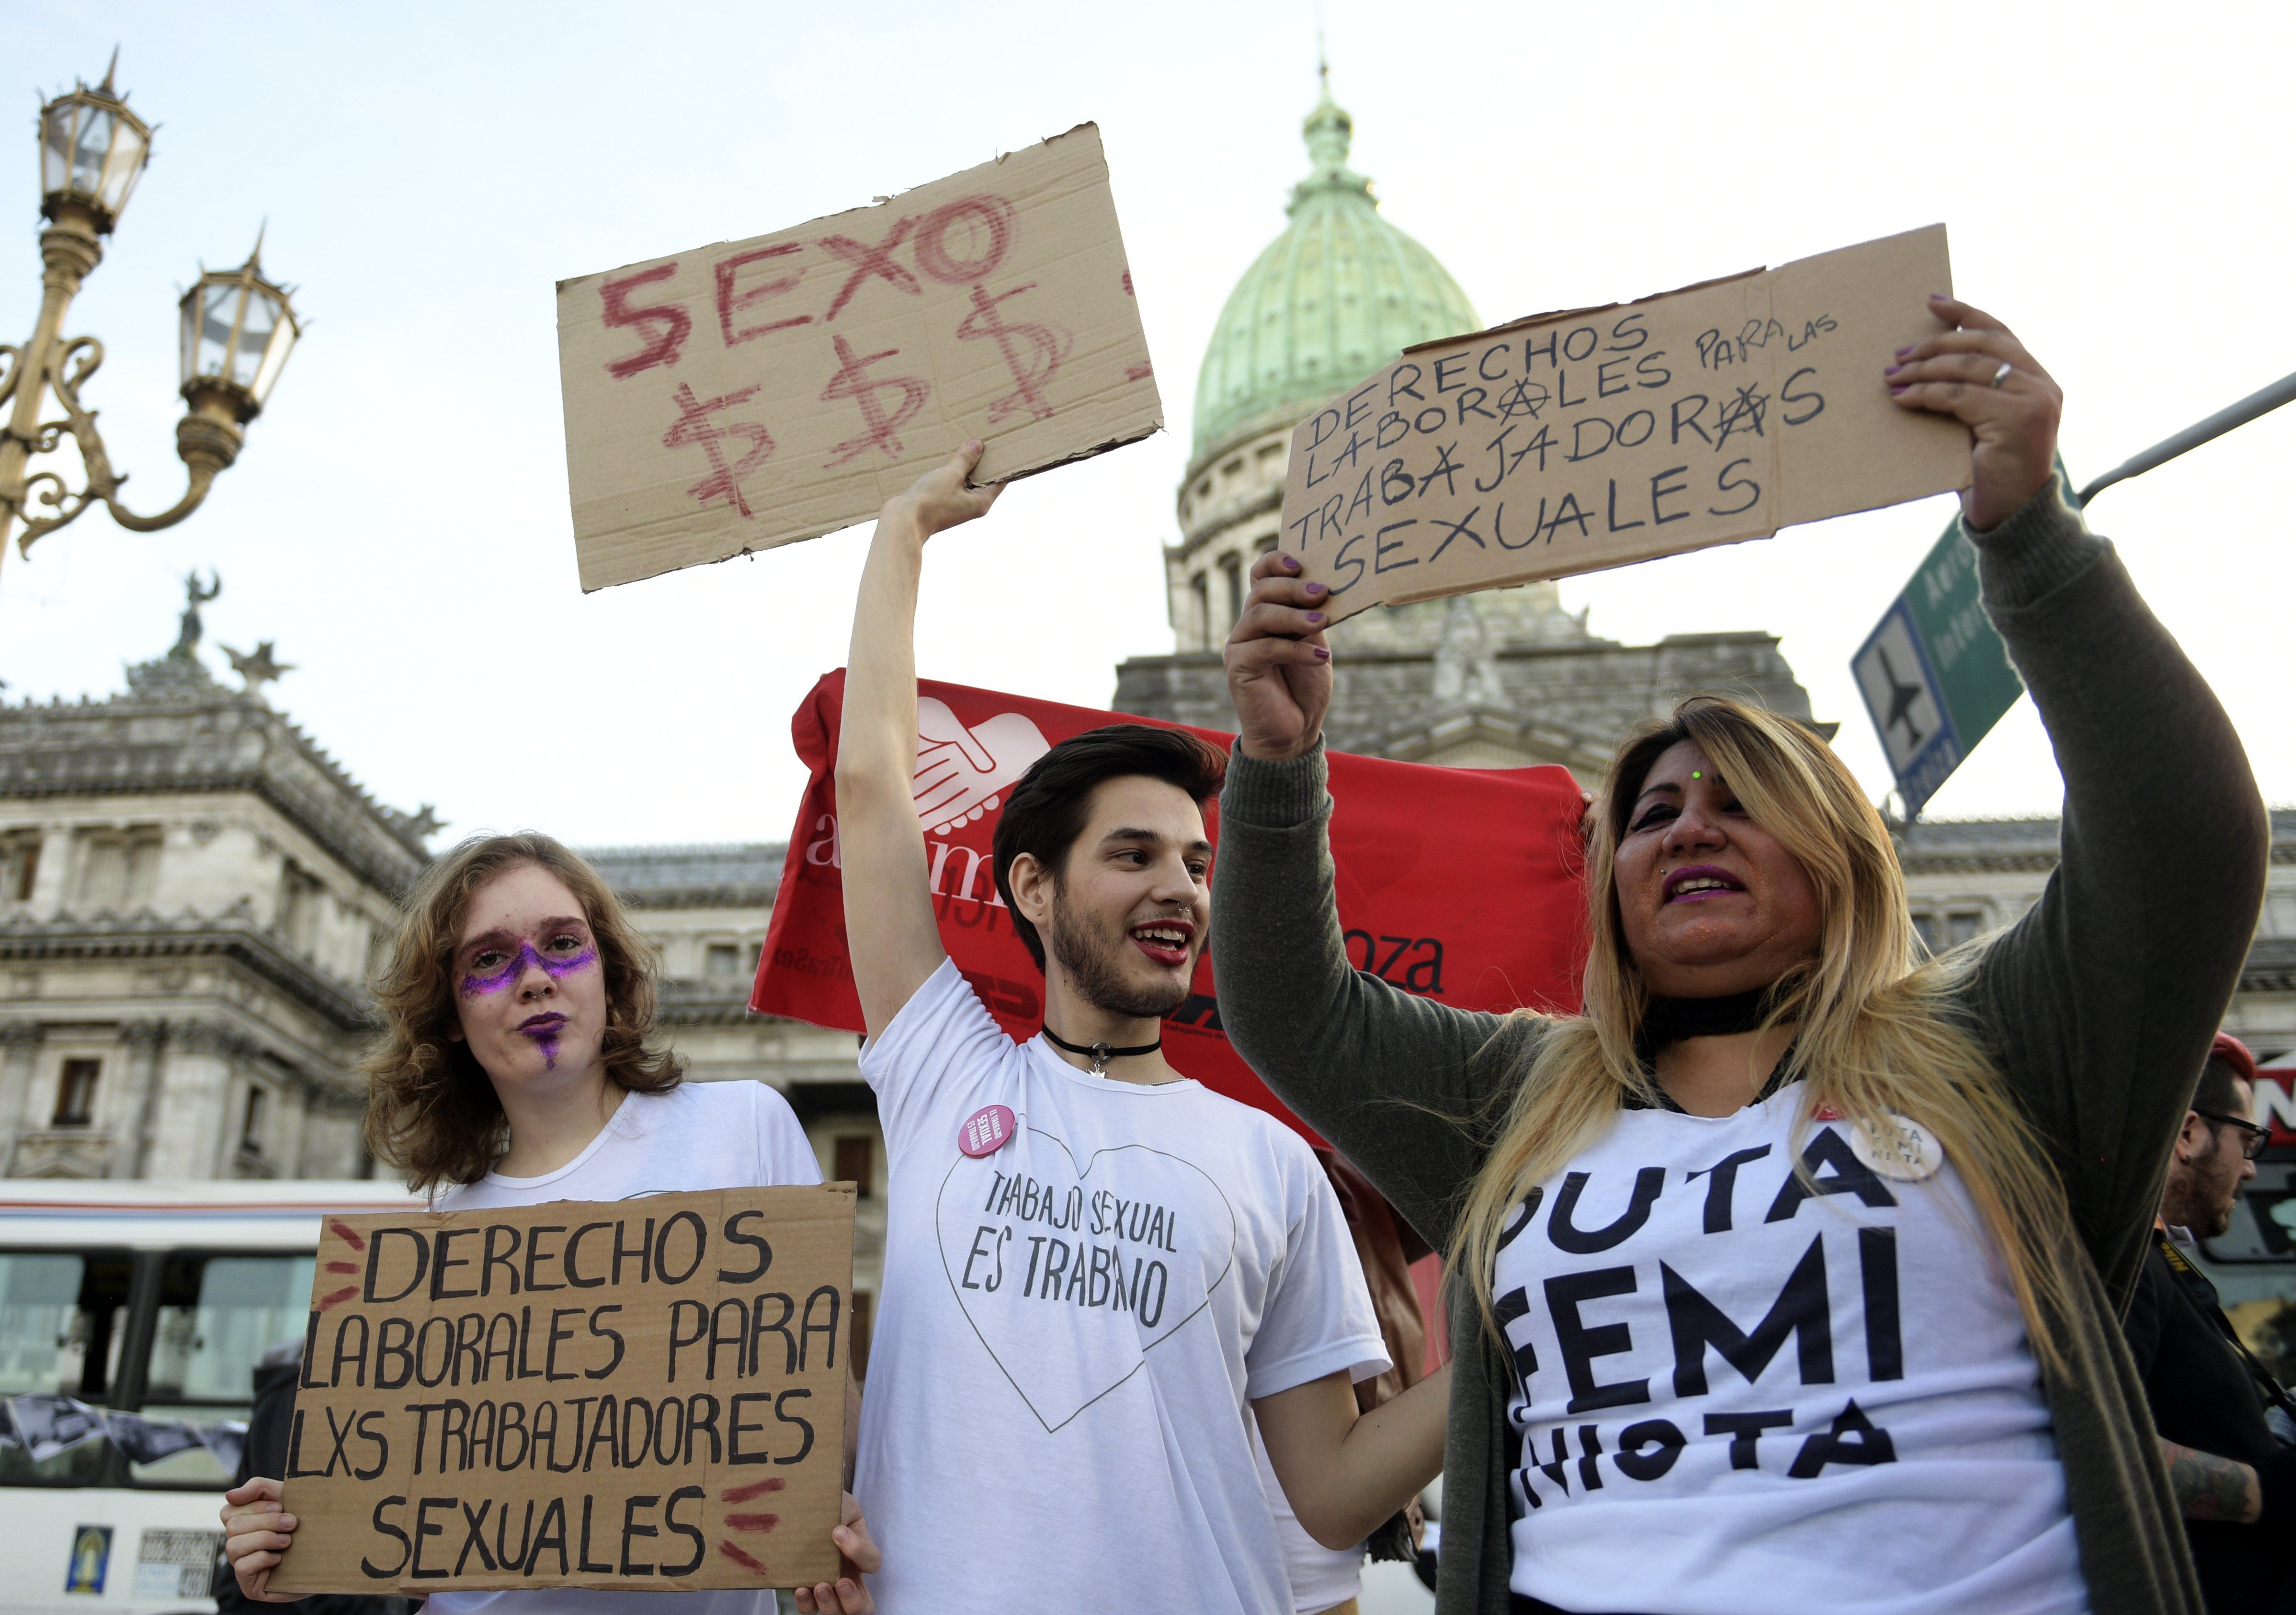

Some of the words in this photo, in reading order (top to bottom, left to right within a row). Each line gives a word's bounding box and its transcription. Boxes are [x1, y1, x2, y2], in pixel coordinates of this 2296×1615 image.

[598, 193, 1021, 379] SEXO
[1304, 313, 1648, 452] DERECHOS
[1307, 350, 1672, 489] LABORALES
[1695, 318, 1785, 370] PARA
[1787, 314, 1838, 351] LAS
[1328, 457, 1760, 596] SEXUALES
[1163, 1024, 1213, 1038] trabajadores
[968, 1126, 980, 1151] TRABAJO
[977, 1114, 992, 1146] SEXUAL
[991, 1115, 1002, 1139] TRABAJO
[363, 1210, 773, 1304] DERECHOS
[961, 1225, 1012, 1293] ES
[1091, 1190, 1177, 1253] SEXUAL
[2160, 1242, 2188, 1272] Niko
[300, 1304, 625, 1390] LABORALES
[667, 1285, 841, 1383] PARA
[286, 1406, 386, 1480] LXS
[404, 1388, 815, 1476] TRABAJADORES
[361, 1485, 706, 1580] SEXUALES
